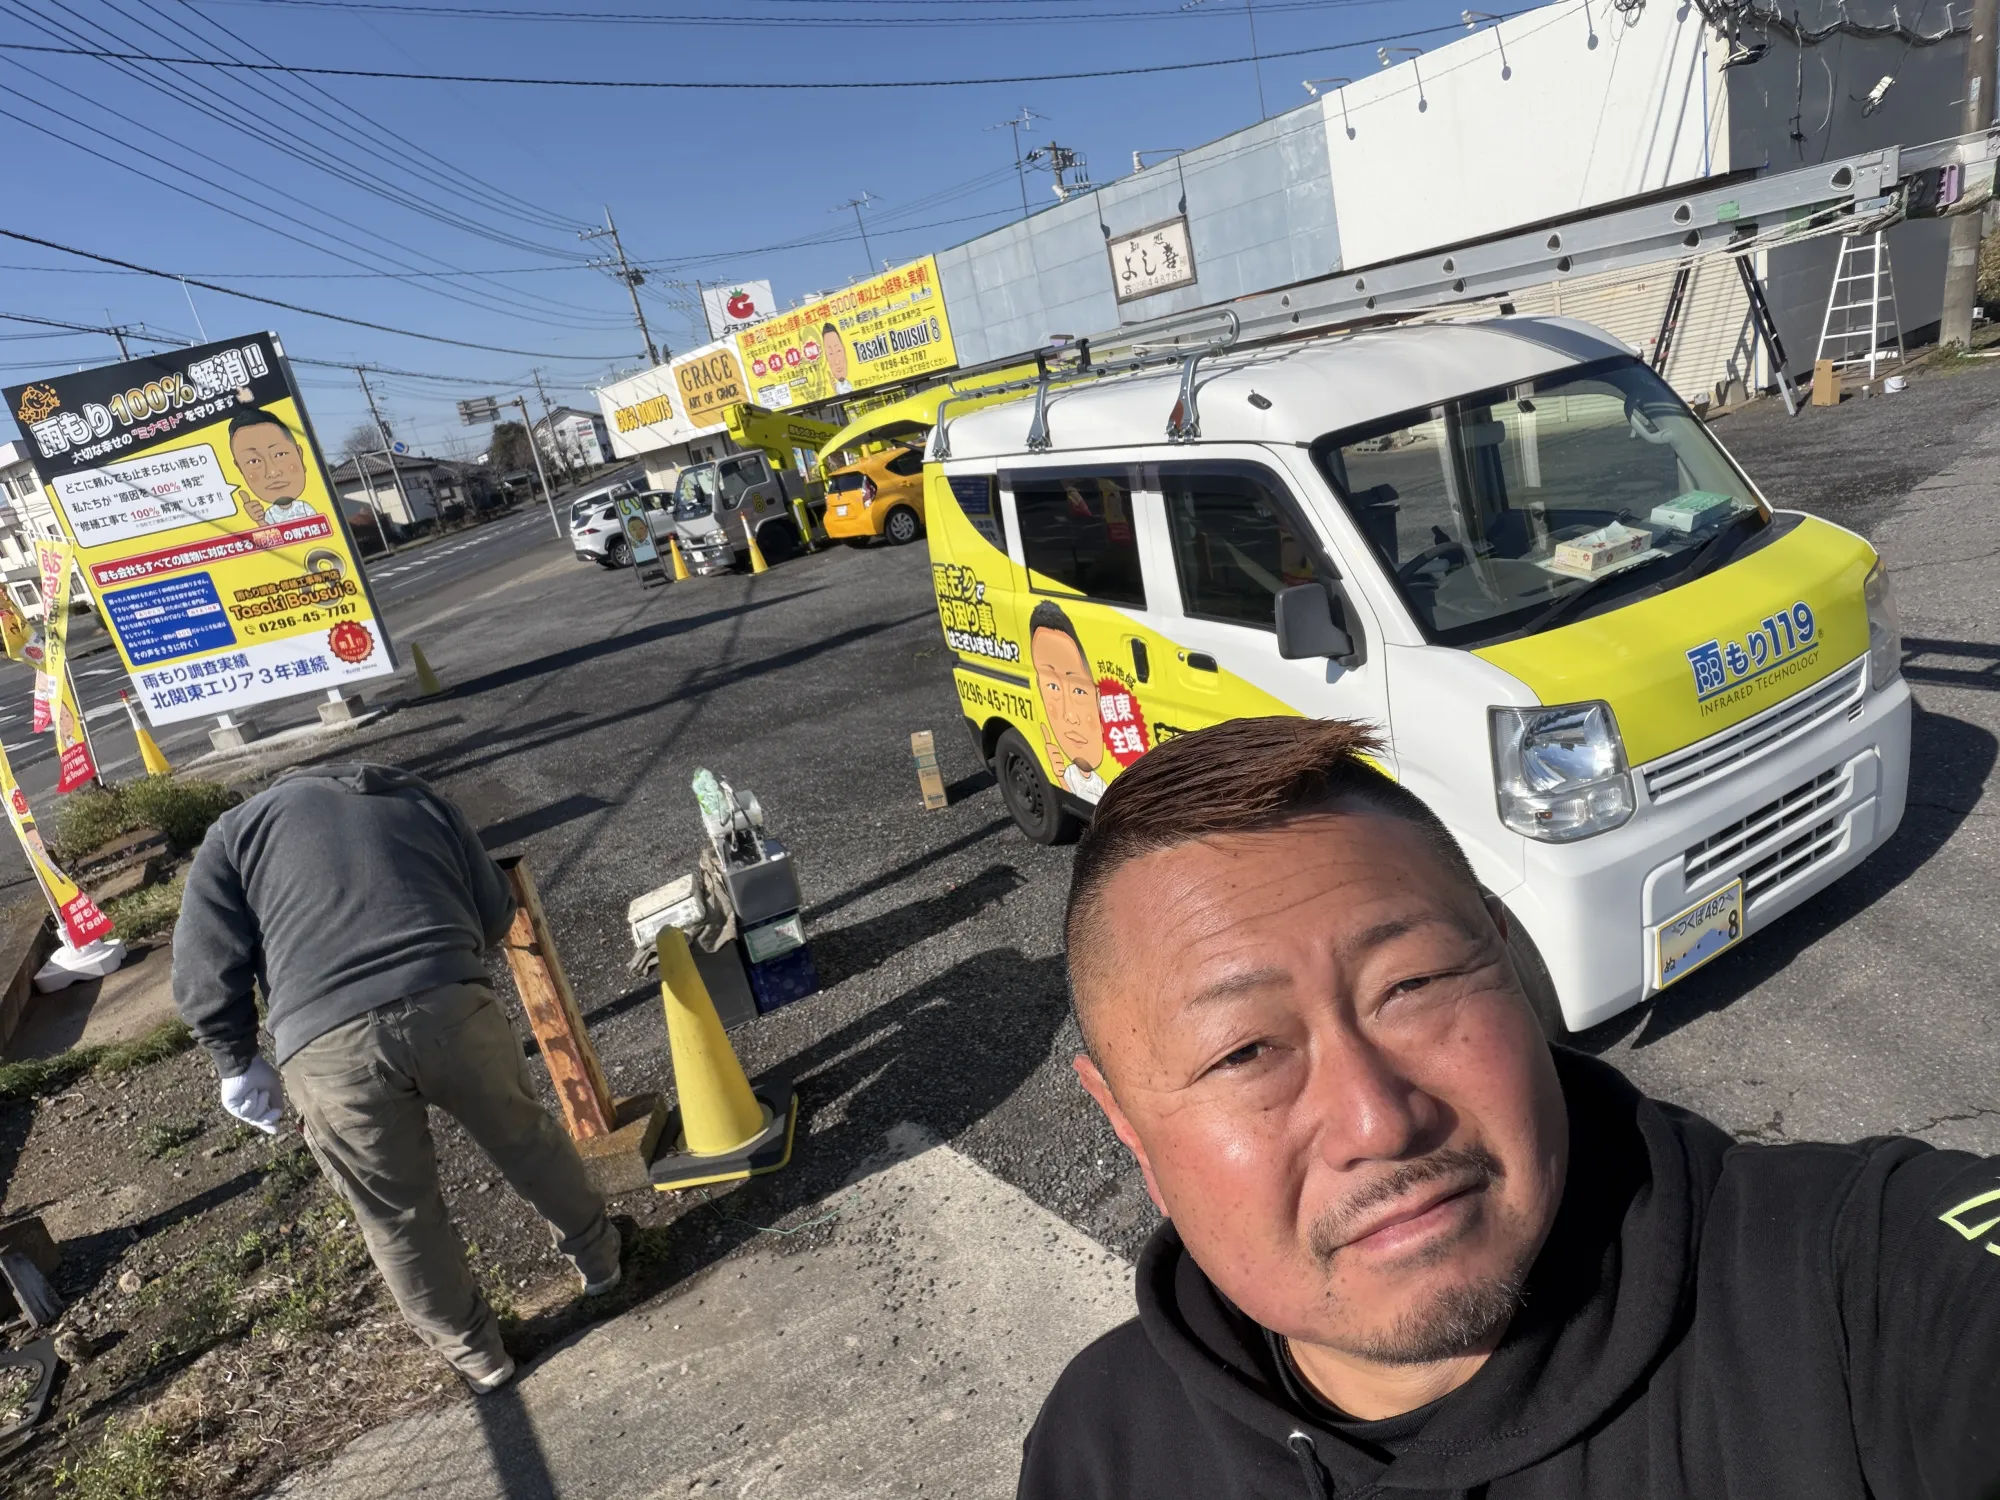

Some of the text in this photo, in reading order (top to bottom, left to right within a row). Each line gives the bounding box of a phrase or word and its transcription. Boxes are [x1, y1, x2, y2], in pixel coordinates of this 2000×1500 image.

[852, 332, 890, 364] Tasaki
[889, 319, 931, 354] Bousui
[929, 315, 941, 342] 8
[680, 354, 733, 392] GRACE
[880, 350, 927, 372] 0296-45-7787
[635, 394, 673, 427] DONUTS
[689, 384, 740, 409] ART OF GRACE
[65, 455, 208, 494] どこに頼んでも止まらない雨もり
[72, 494, 112, 513] 私たちが
[151, 482, 181, 496] 100%
[130, 506, 161, 521] 100%
[932, 563, 985, 600] 雨もりで
[229, 580, 357, 621] Tasaki Bousui 8
[258, 602, 357, 633] 0296-45-7787
[939, 598, 996, 637] お困り事
[1685, 601, 1816, 696] 雨もり119
[140, 652, 251, 690] 雨もり調査実績
[1097, 659, 1137, 691] 対応地域
[1700, 651, 1819, 717] INFRARED TECHNOLOGY
[957, 679, 1034, 721] 0296-45-7787
[1100, 693, 1134, 723] 関東
[1109, 724, 1145, 753] 全域
